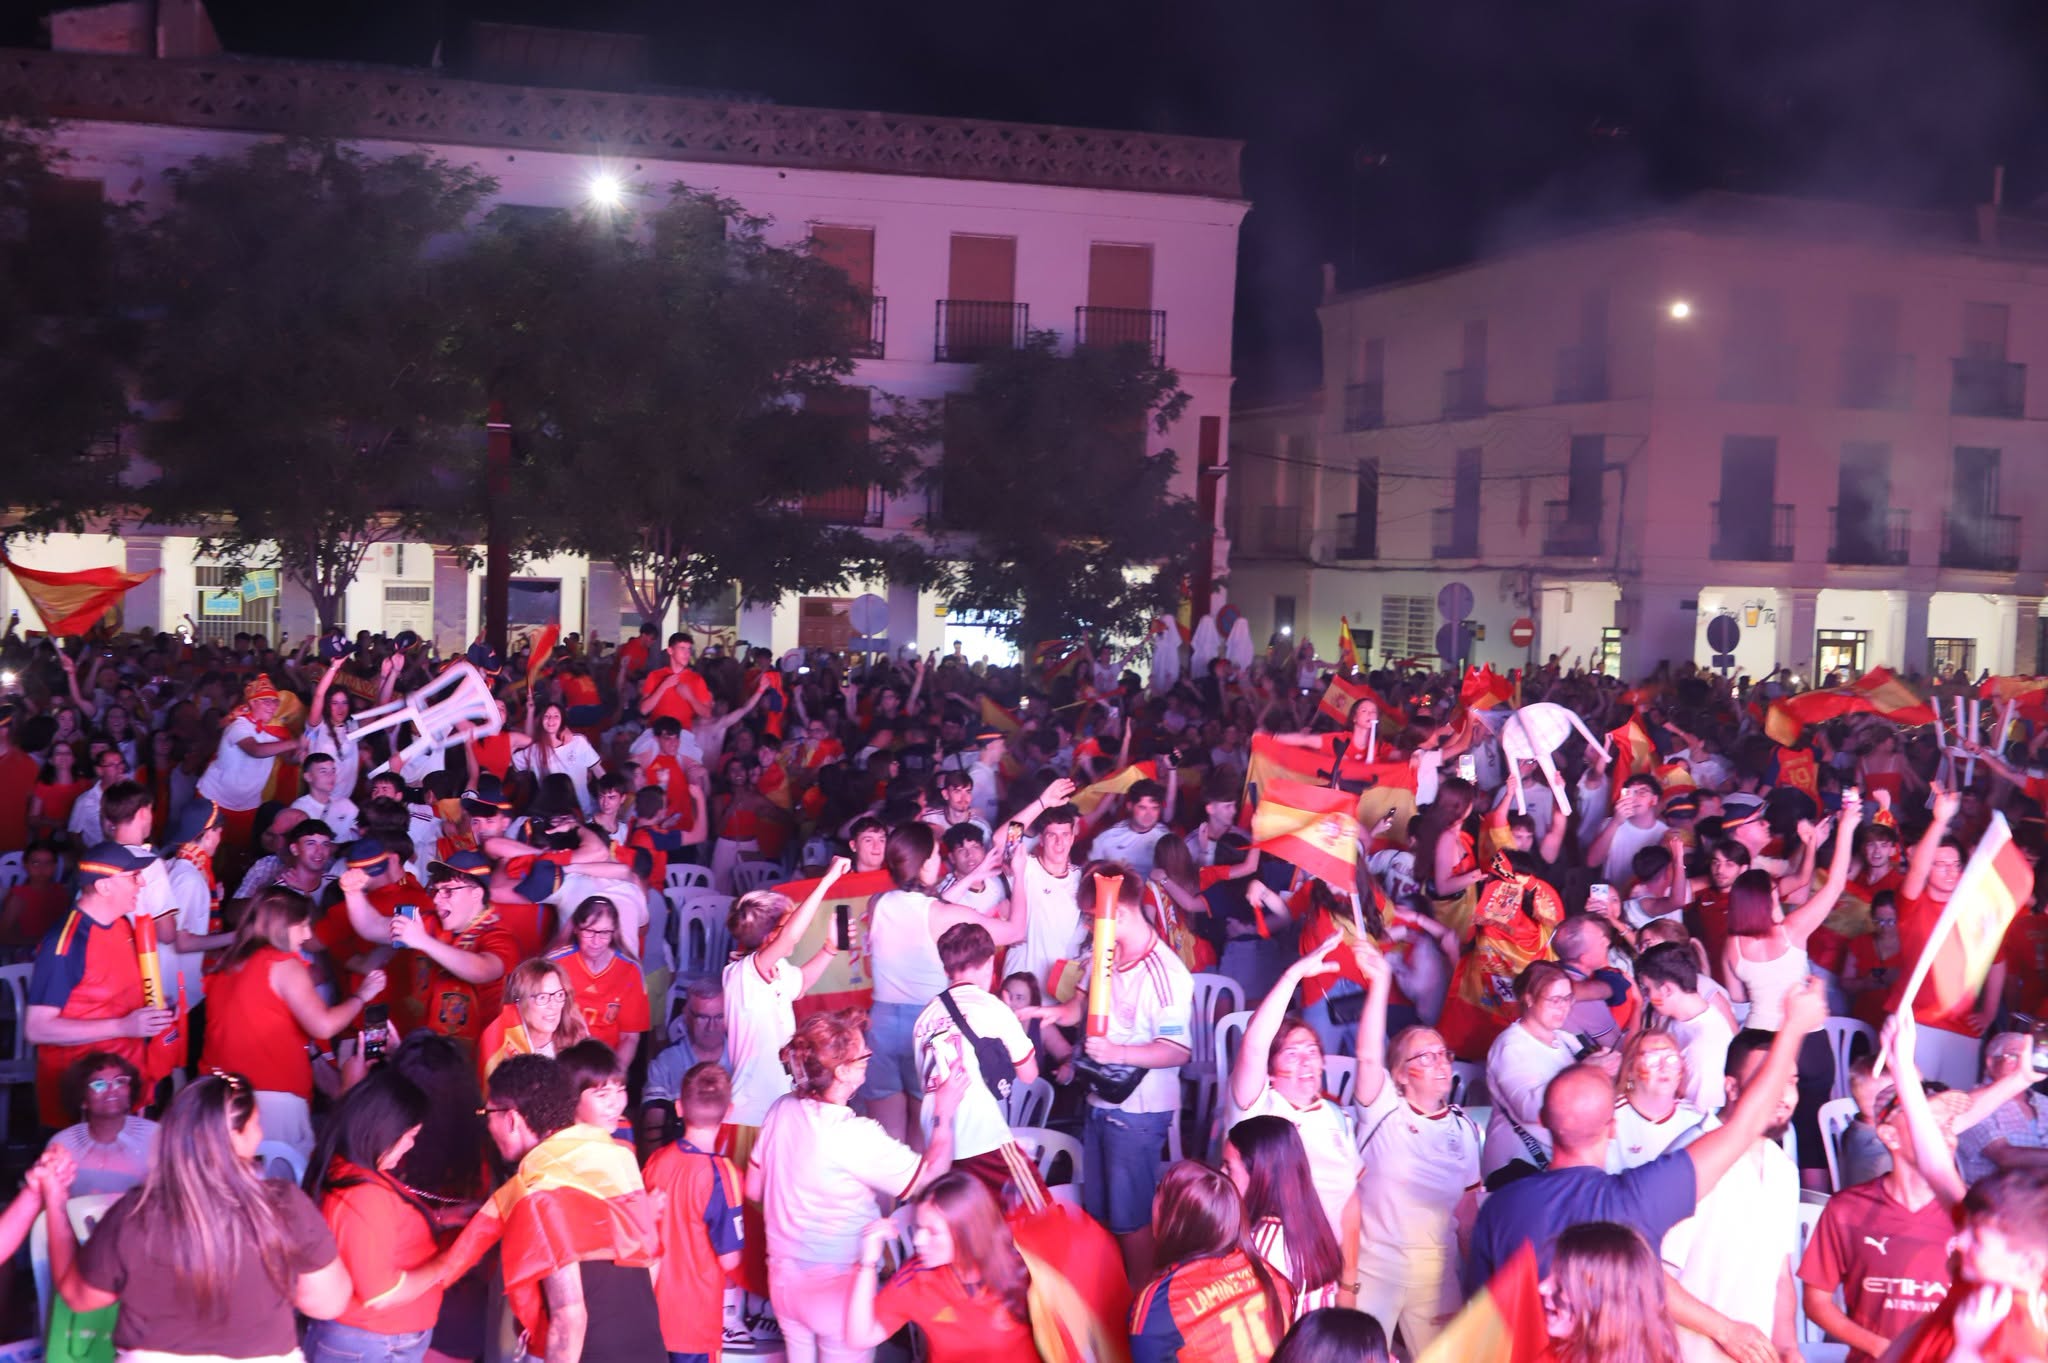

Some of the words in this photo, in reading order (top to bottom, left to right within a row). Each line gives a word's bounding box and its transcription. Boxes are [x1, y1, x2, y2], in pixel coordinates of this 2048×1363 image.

[1185, 1271, 1244, 1317] LAMINE
[1862, 1276, 1952, 1298] ETIHA
[1883, 1298, 1940, 1313] AIRWAY
